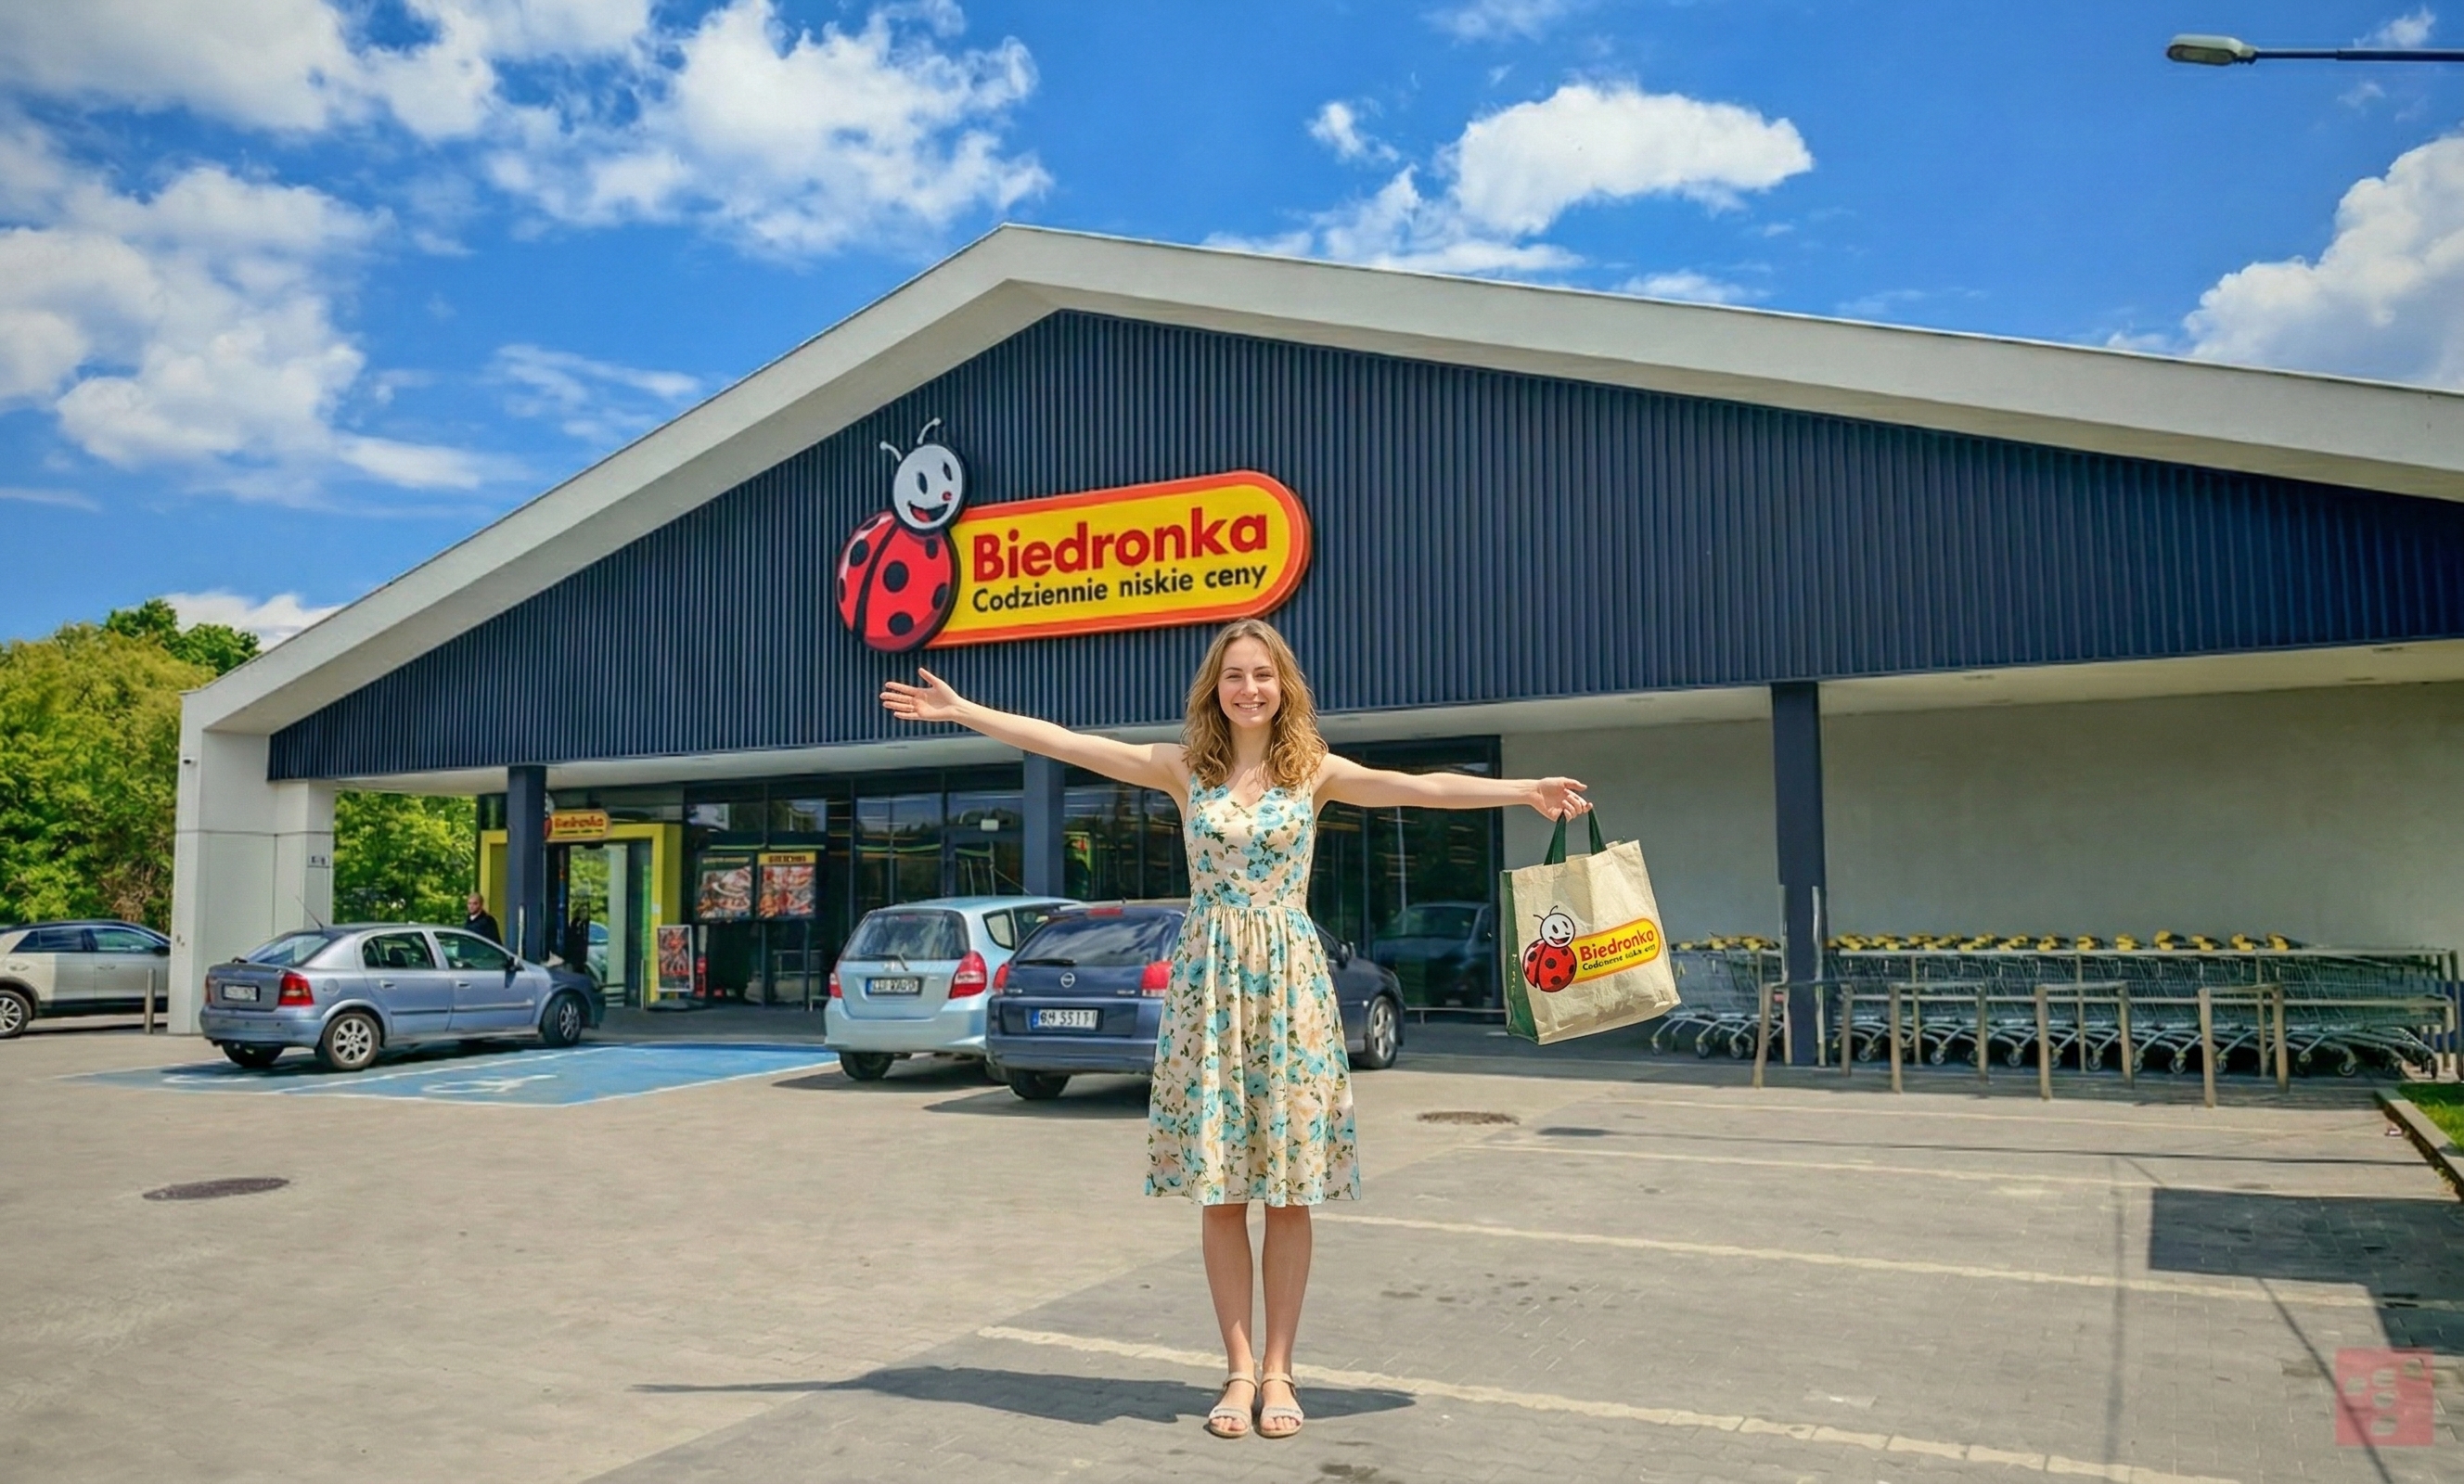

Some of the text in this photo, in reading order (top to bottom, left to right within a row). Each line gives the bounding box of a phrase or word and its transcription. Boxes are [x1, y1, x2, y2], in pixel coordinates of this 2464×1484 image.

[973, 506, 1267, 582] Biedronka
[972, 565, 1267, 612] Codziennie niskie ceny
